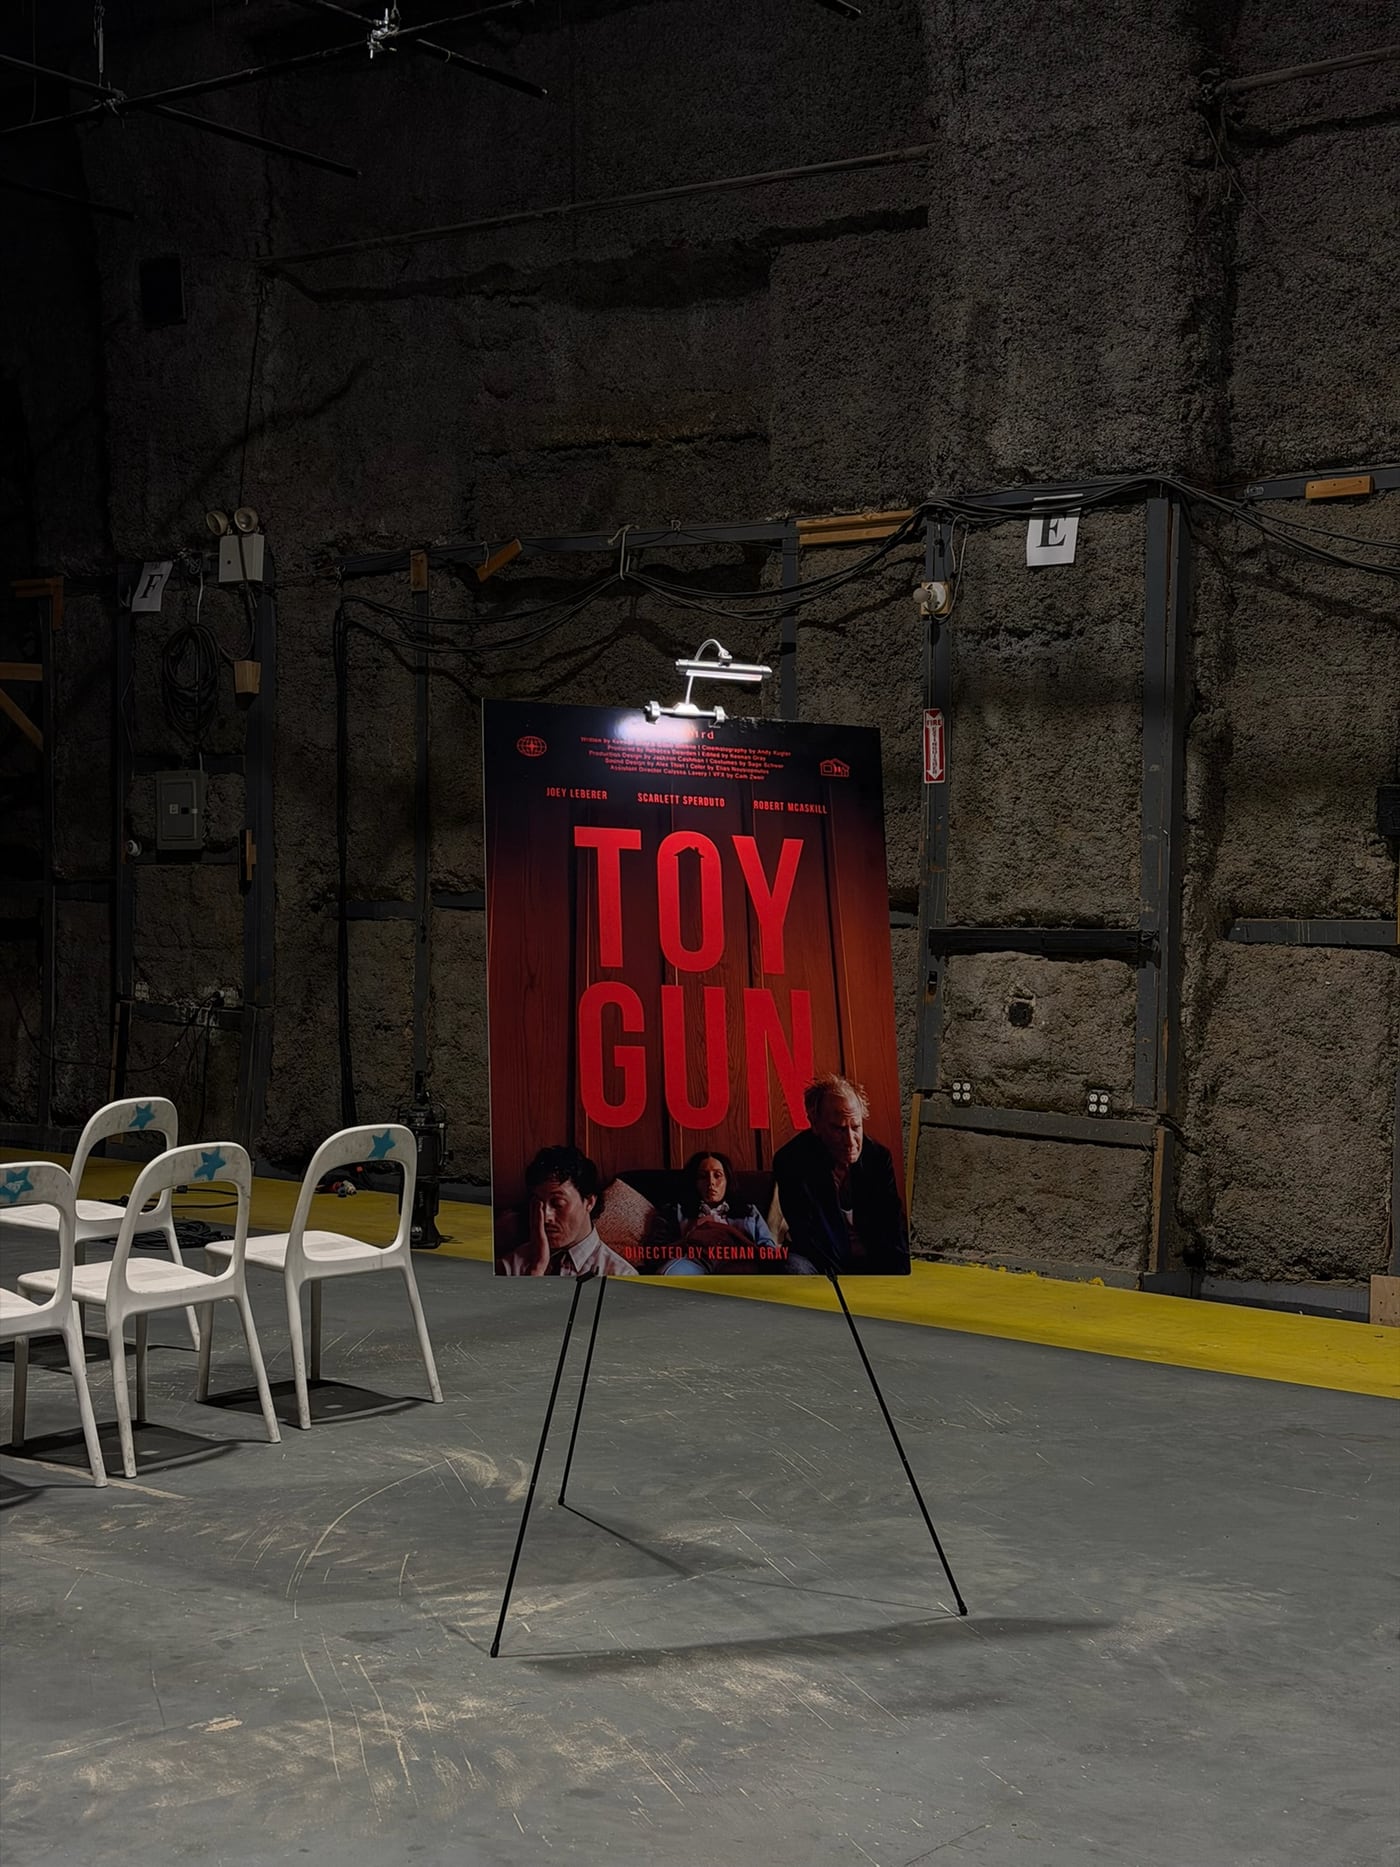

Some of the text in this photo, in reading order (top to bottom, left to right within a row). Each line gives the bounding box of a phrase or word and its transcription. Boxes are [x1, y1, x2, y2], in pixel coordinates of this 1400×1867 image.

[1035, 511, 1067, 548] E
[139, 574, 163, 599] F
[546, 787, 608, 800] JOEY LEBERER
[637, 792, 680, 805] SCARLETT
[753, 800, 828, 815] ROBERT MCASKILL
[574, 826, 804, 974] TOY
[578, 981, 815, 1131] GUN
[625, 1246, 789, 1260] DIRECTED BY KEENAN GRAY
